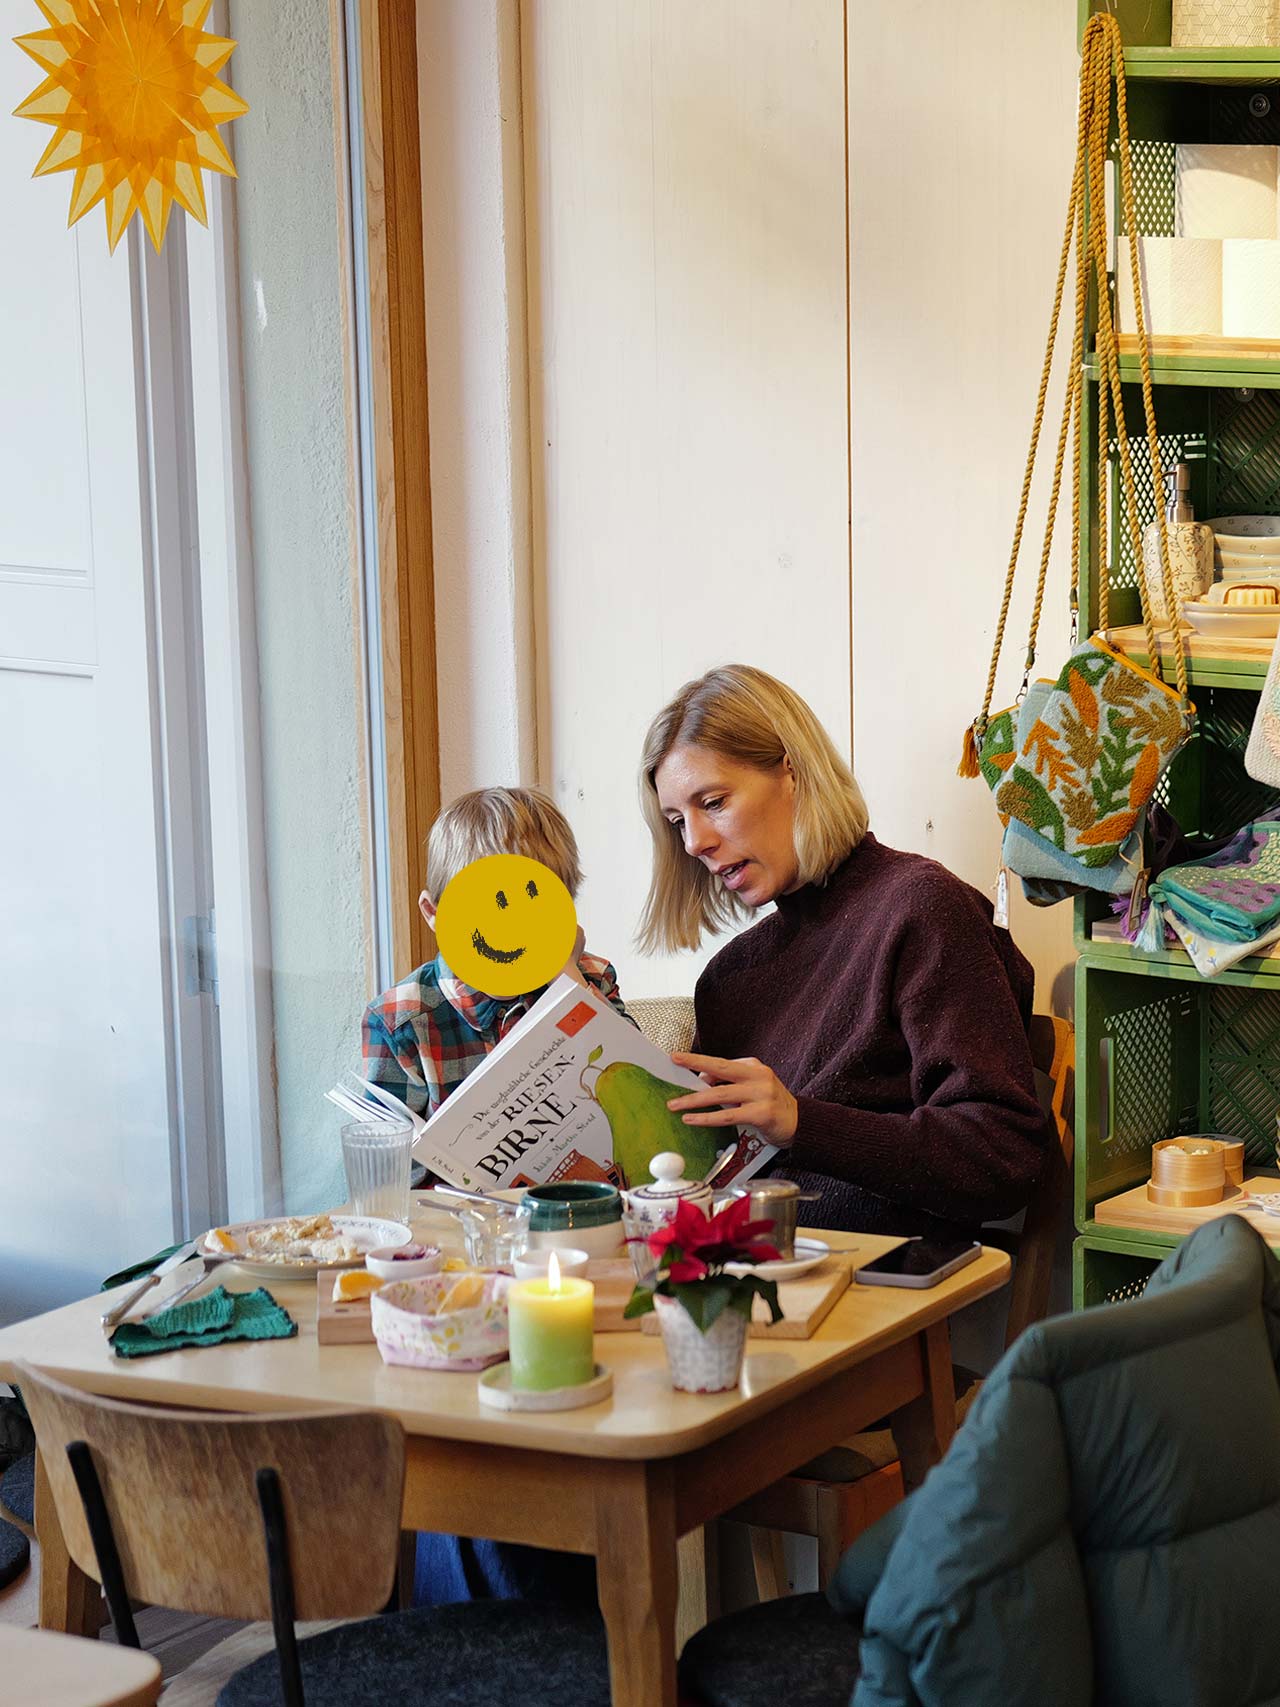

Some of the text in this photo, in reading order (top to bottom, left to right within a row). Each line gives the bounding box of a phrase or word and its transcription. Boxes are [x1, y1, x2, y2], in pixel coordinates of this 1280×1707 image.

[472, 1108, 491, 1123] Die
[529, 1036, 566, 1071] Geschichte
[488, 1118, 501, 1131] der
[500, 1053, 576, 1123] RIESEN-
[474, 1092, 578, 1183] BIRNE
